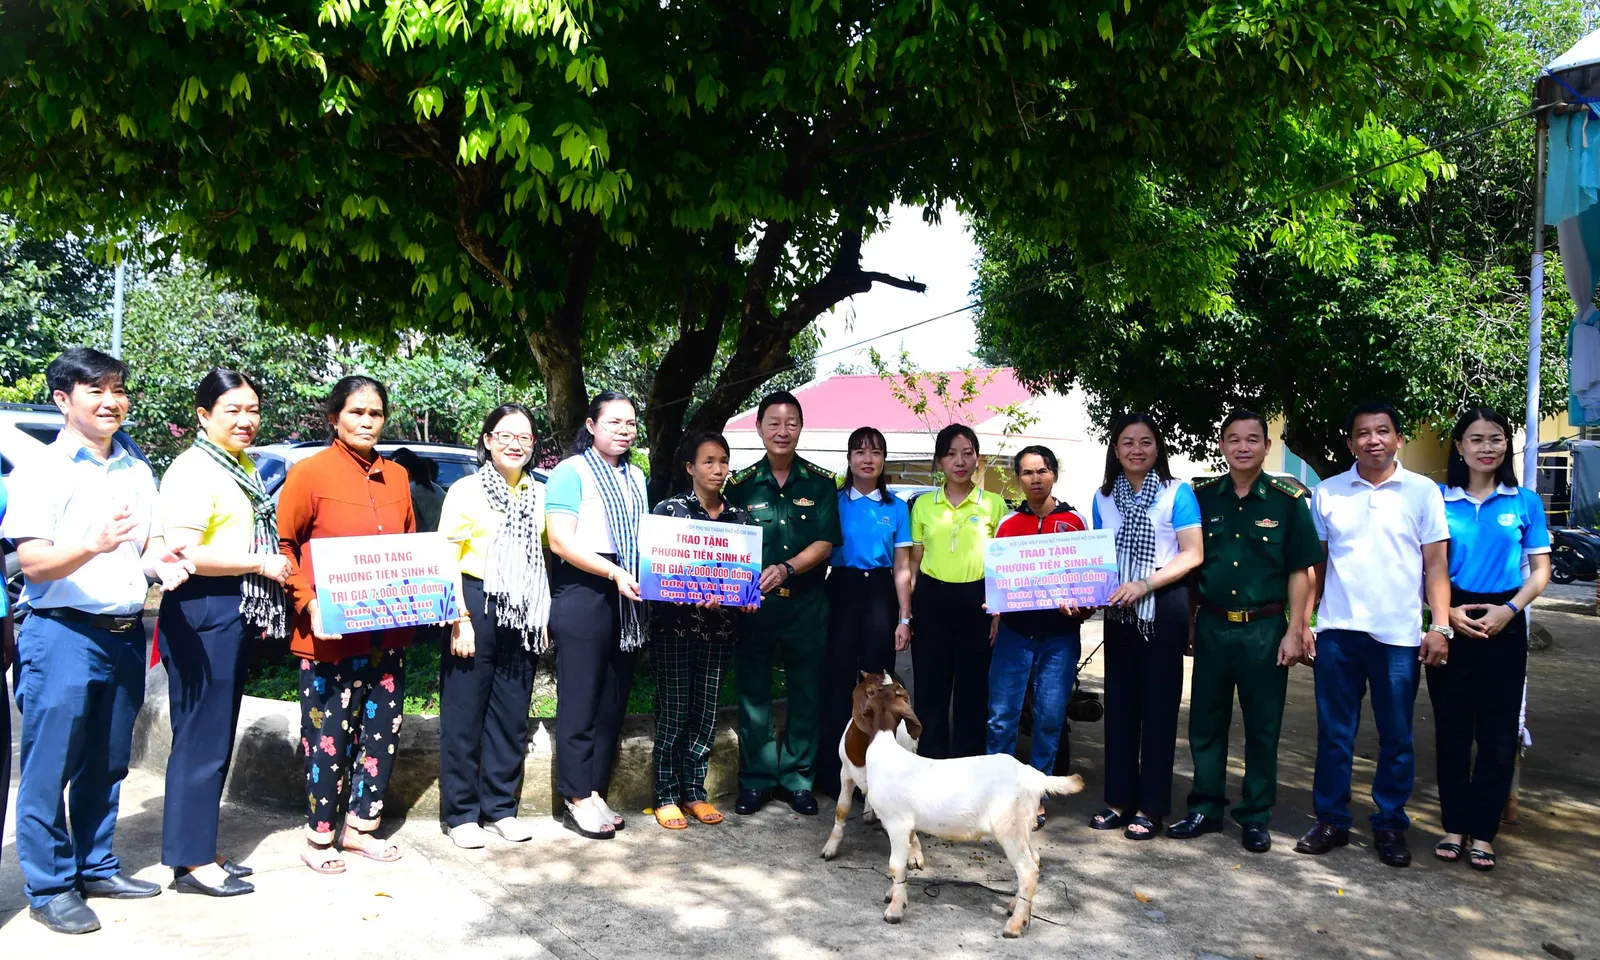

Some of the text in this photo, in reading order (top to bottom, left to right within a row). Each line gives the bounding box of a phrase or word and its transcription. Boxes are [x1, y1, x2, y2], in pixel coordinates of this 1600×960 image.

[676, 533, 729, 548] TRAO TẶNG
[651, 546, 752, 564] PHƯƠNG TIỆN SINH KẾ
[1019, 545, 1077, 559] TRAO TẶNG
[353, 553, 381, 566] TRAO
[995, 554, 1104, 574] PHƯƠNG TIỆN SINH KẾ
[401, 567, 425, 578] SINH
[651, 563, 666, 576] TRỊ
[668, 561, 684, 575] GIÁ
[686, 565, 729, 578] 7.000.000
[996, 577, 1011, 589] TRỊ
[1032, 573, 1080, 586] 7.000.000
[371, 585, 418, 599] 7.000.000
[1080, 595, 1095, 603] 14
